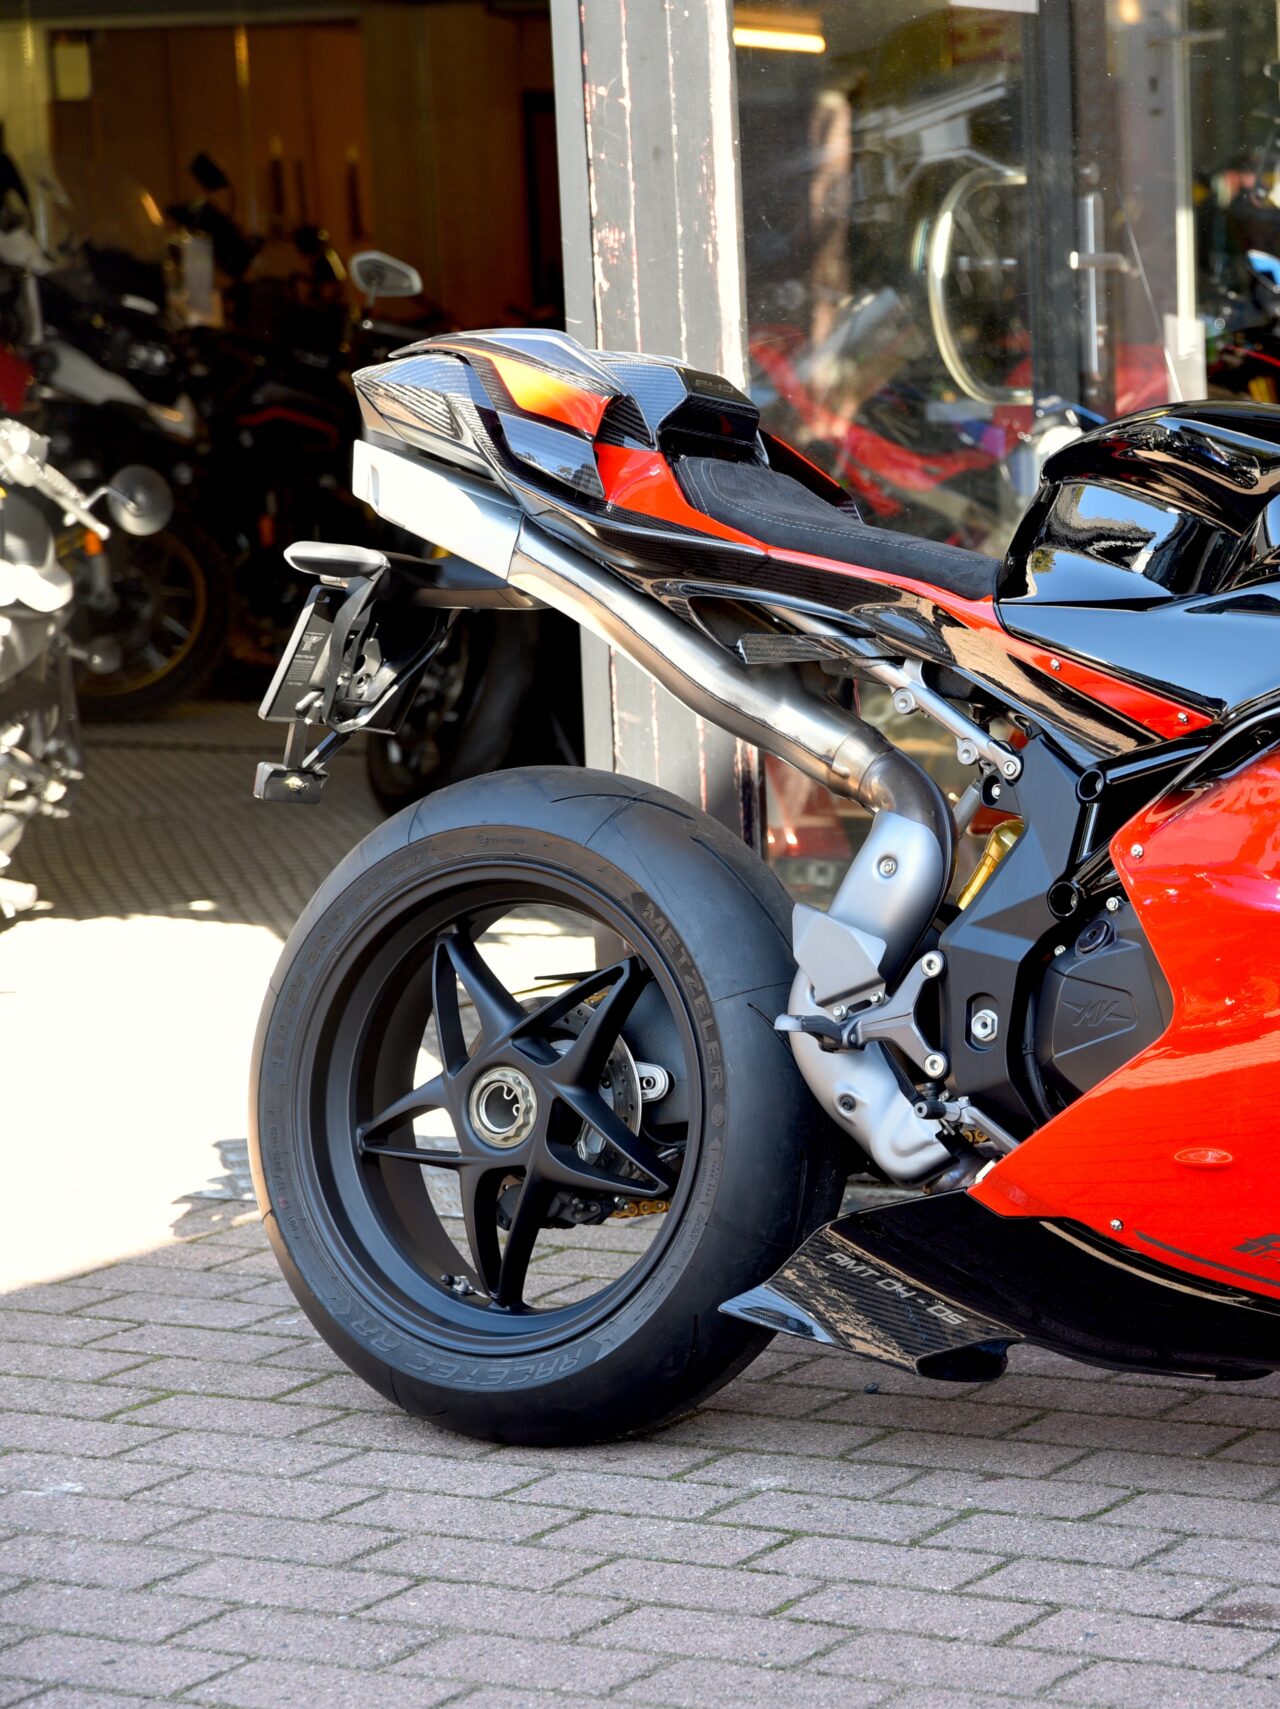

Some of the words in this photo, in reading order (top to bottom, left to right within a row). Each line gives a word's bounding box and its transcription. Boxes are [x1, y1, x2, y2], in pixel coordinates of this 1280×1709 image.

[639, 900, 727, 1093] METZELER
[825, 1252, 881, 1277] AMT
[405, 1344, 586, 1387] RACETEC
